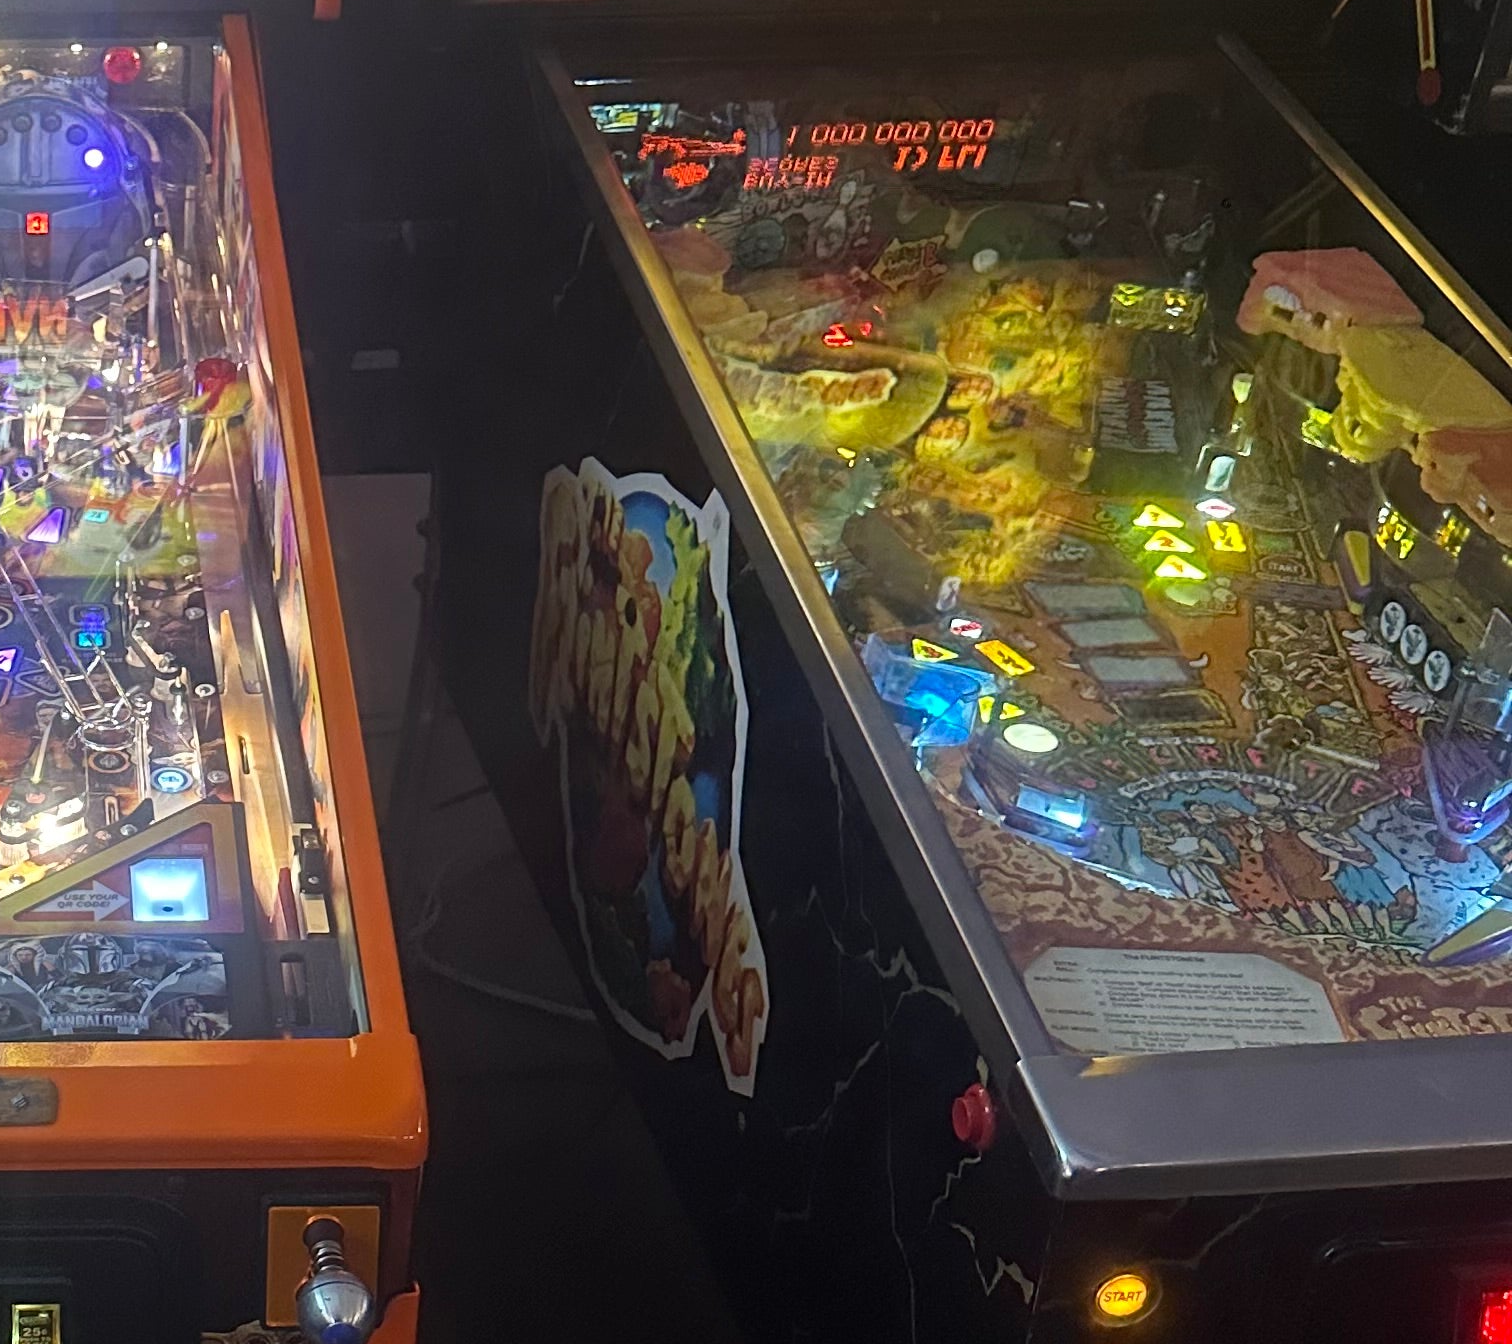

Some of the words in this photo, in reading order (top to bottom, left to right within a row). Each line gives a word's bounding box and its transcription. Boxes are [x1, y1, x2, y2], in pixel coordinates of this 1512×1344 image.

[64, 894, 87, 902] USE
[89, 893, 119, 901] YOUR
[57, 901, 75, 909] QR
[1379, 996, 1427, 1013] THE
[42, 1014, 150, 1029] MANDALORIAN
[1103, 1291, 1143, 1302] START
